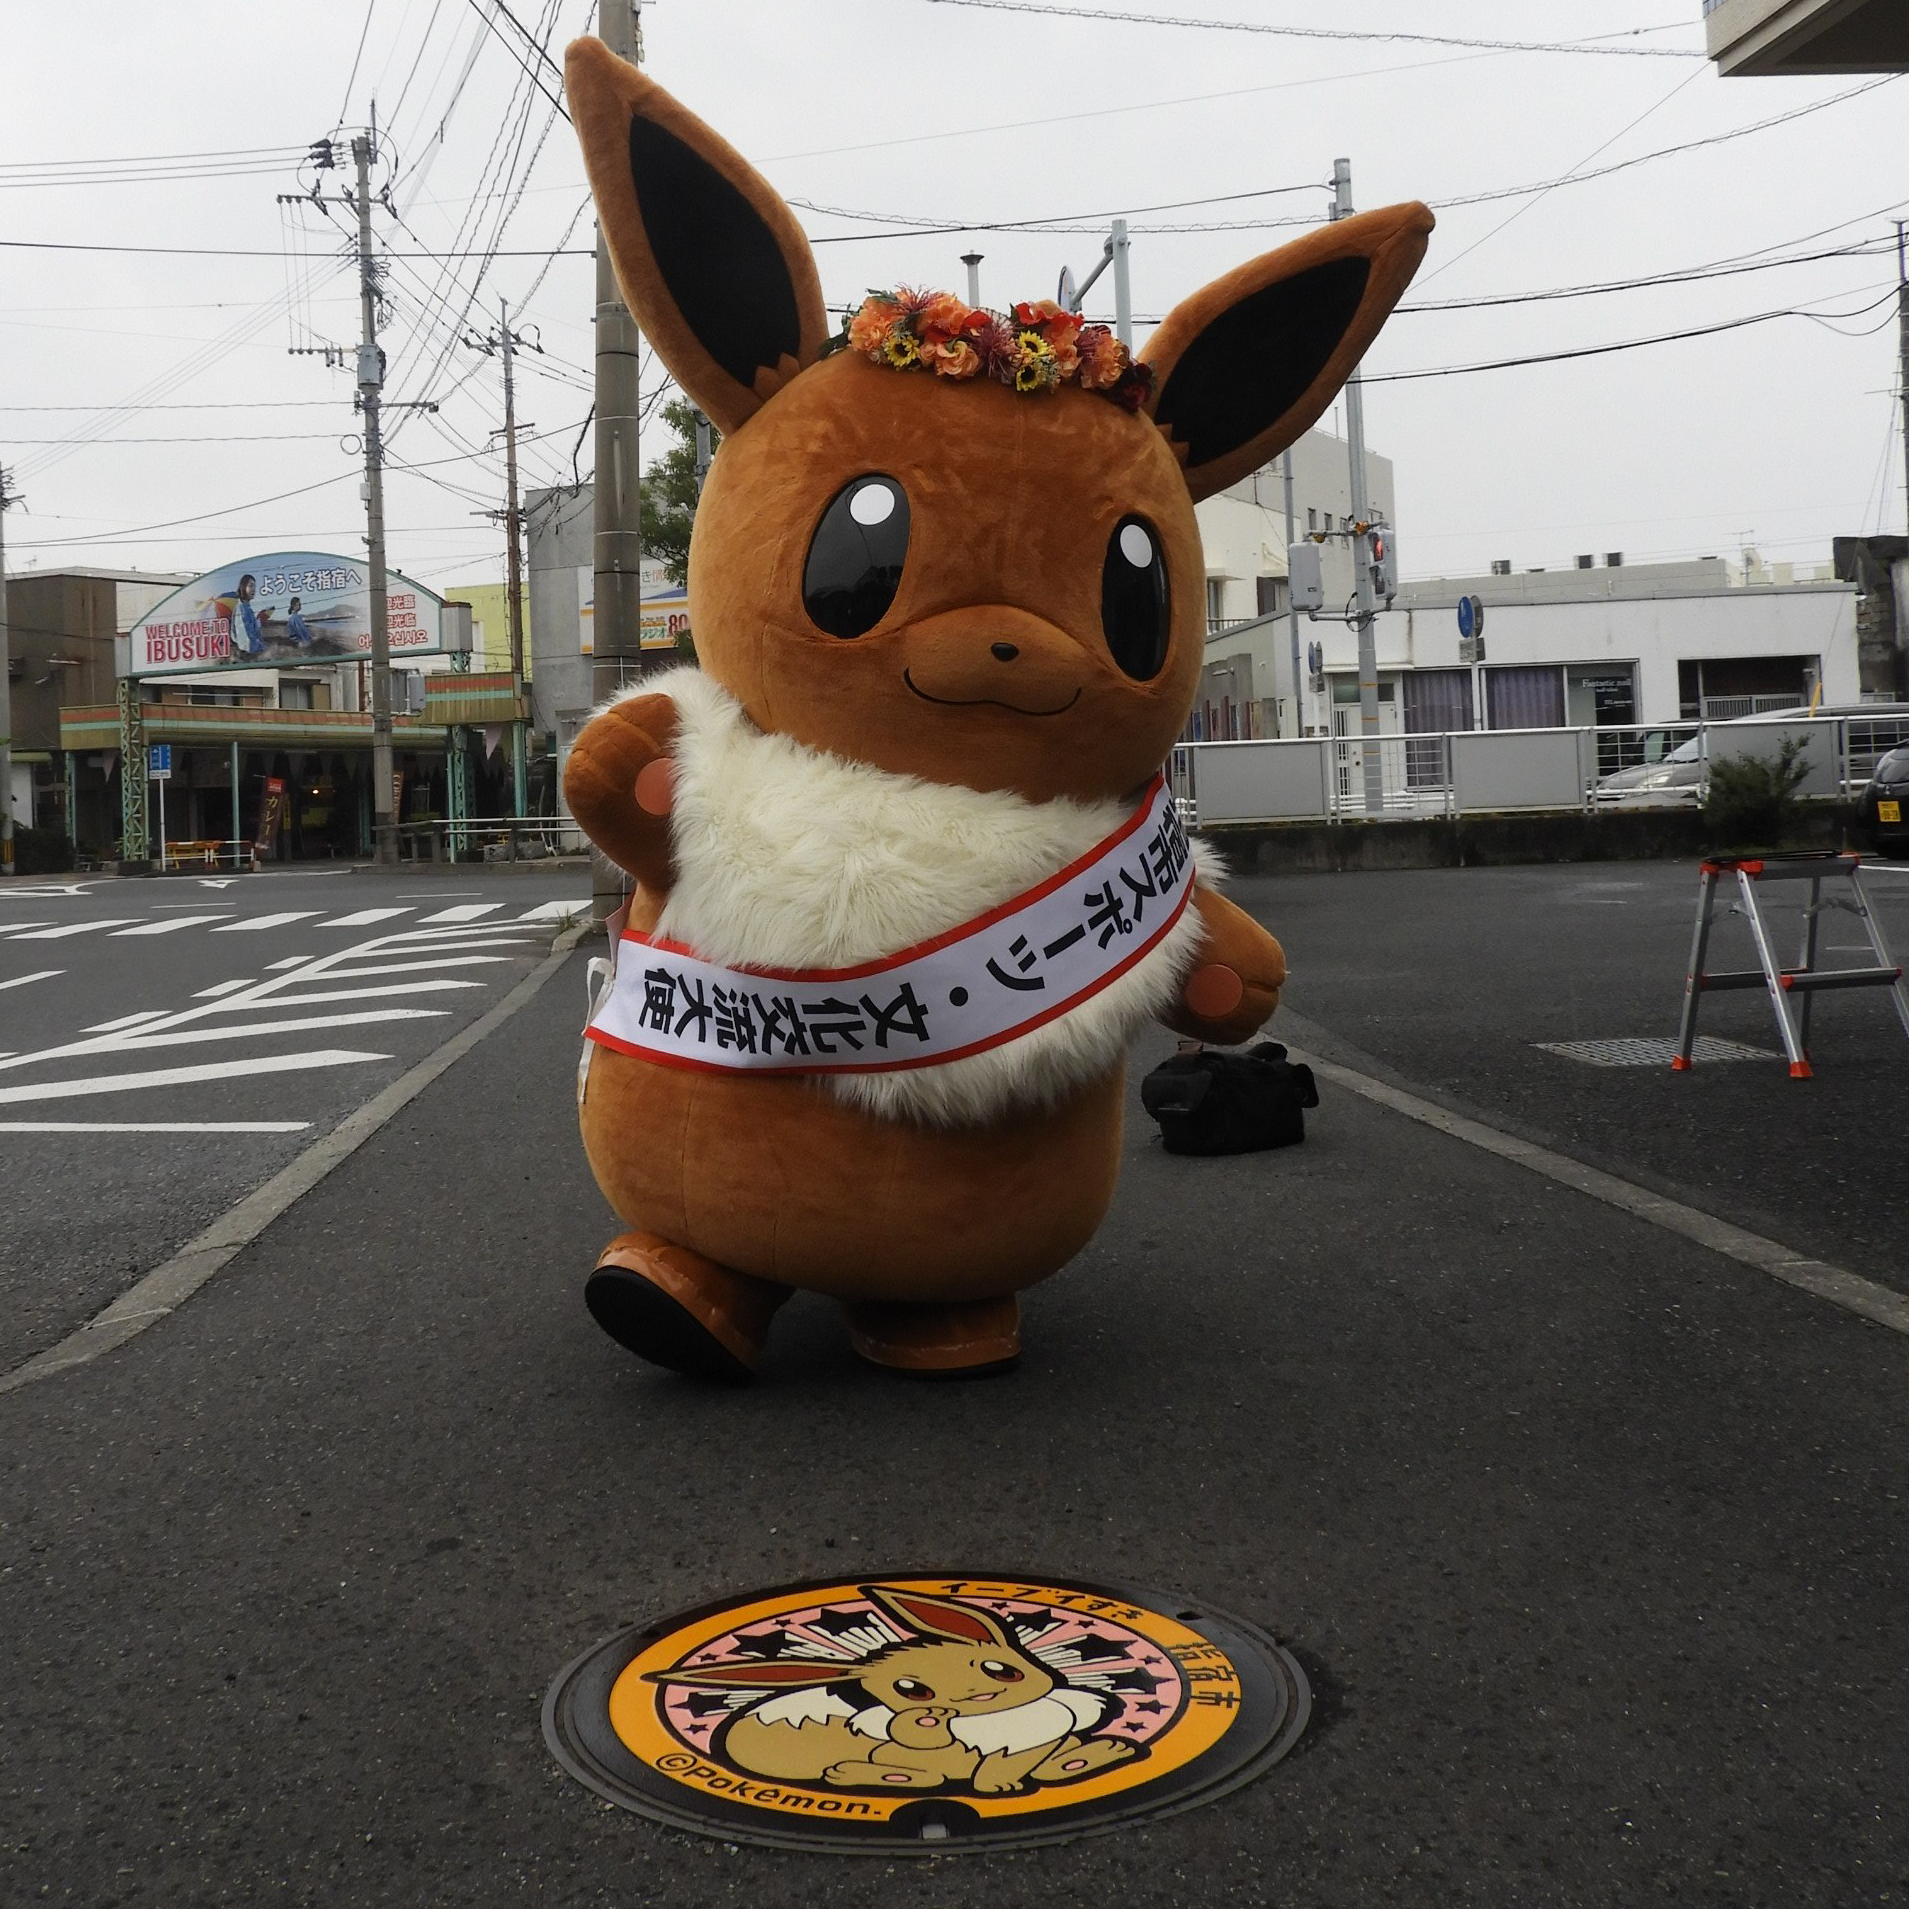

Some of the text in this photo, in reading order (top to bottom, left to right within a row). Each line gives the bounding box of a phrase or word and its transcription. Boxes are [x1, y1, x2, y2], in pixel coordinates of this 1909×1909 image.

[260, 567, 362, 596] ようこそ指宿へ
[146, 619, 230, 640] WELCOME TO
[358, 633, 372, 648] 어
[146, 634, 230, 664] IBUSUKI
[265, 796, 279, 836] カレー
